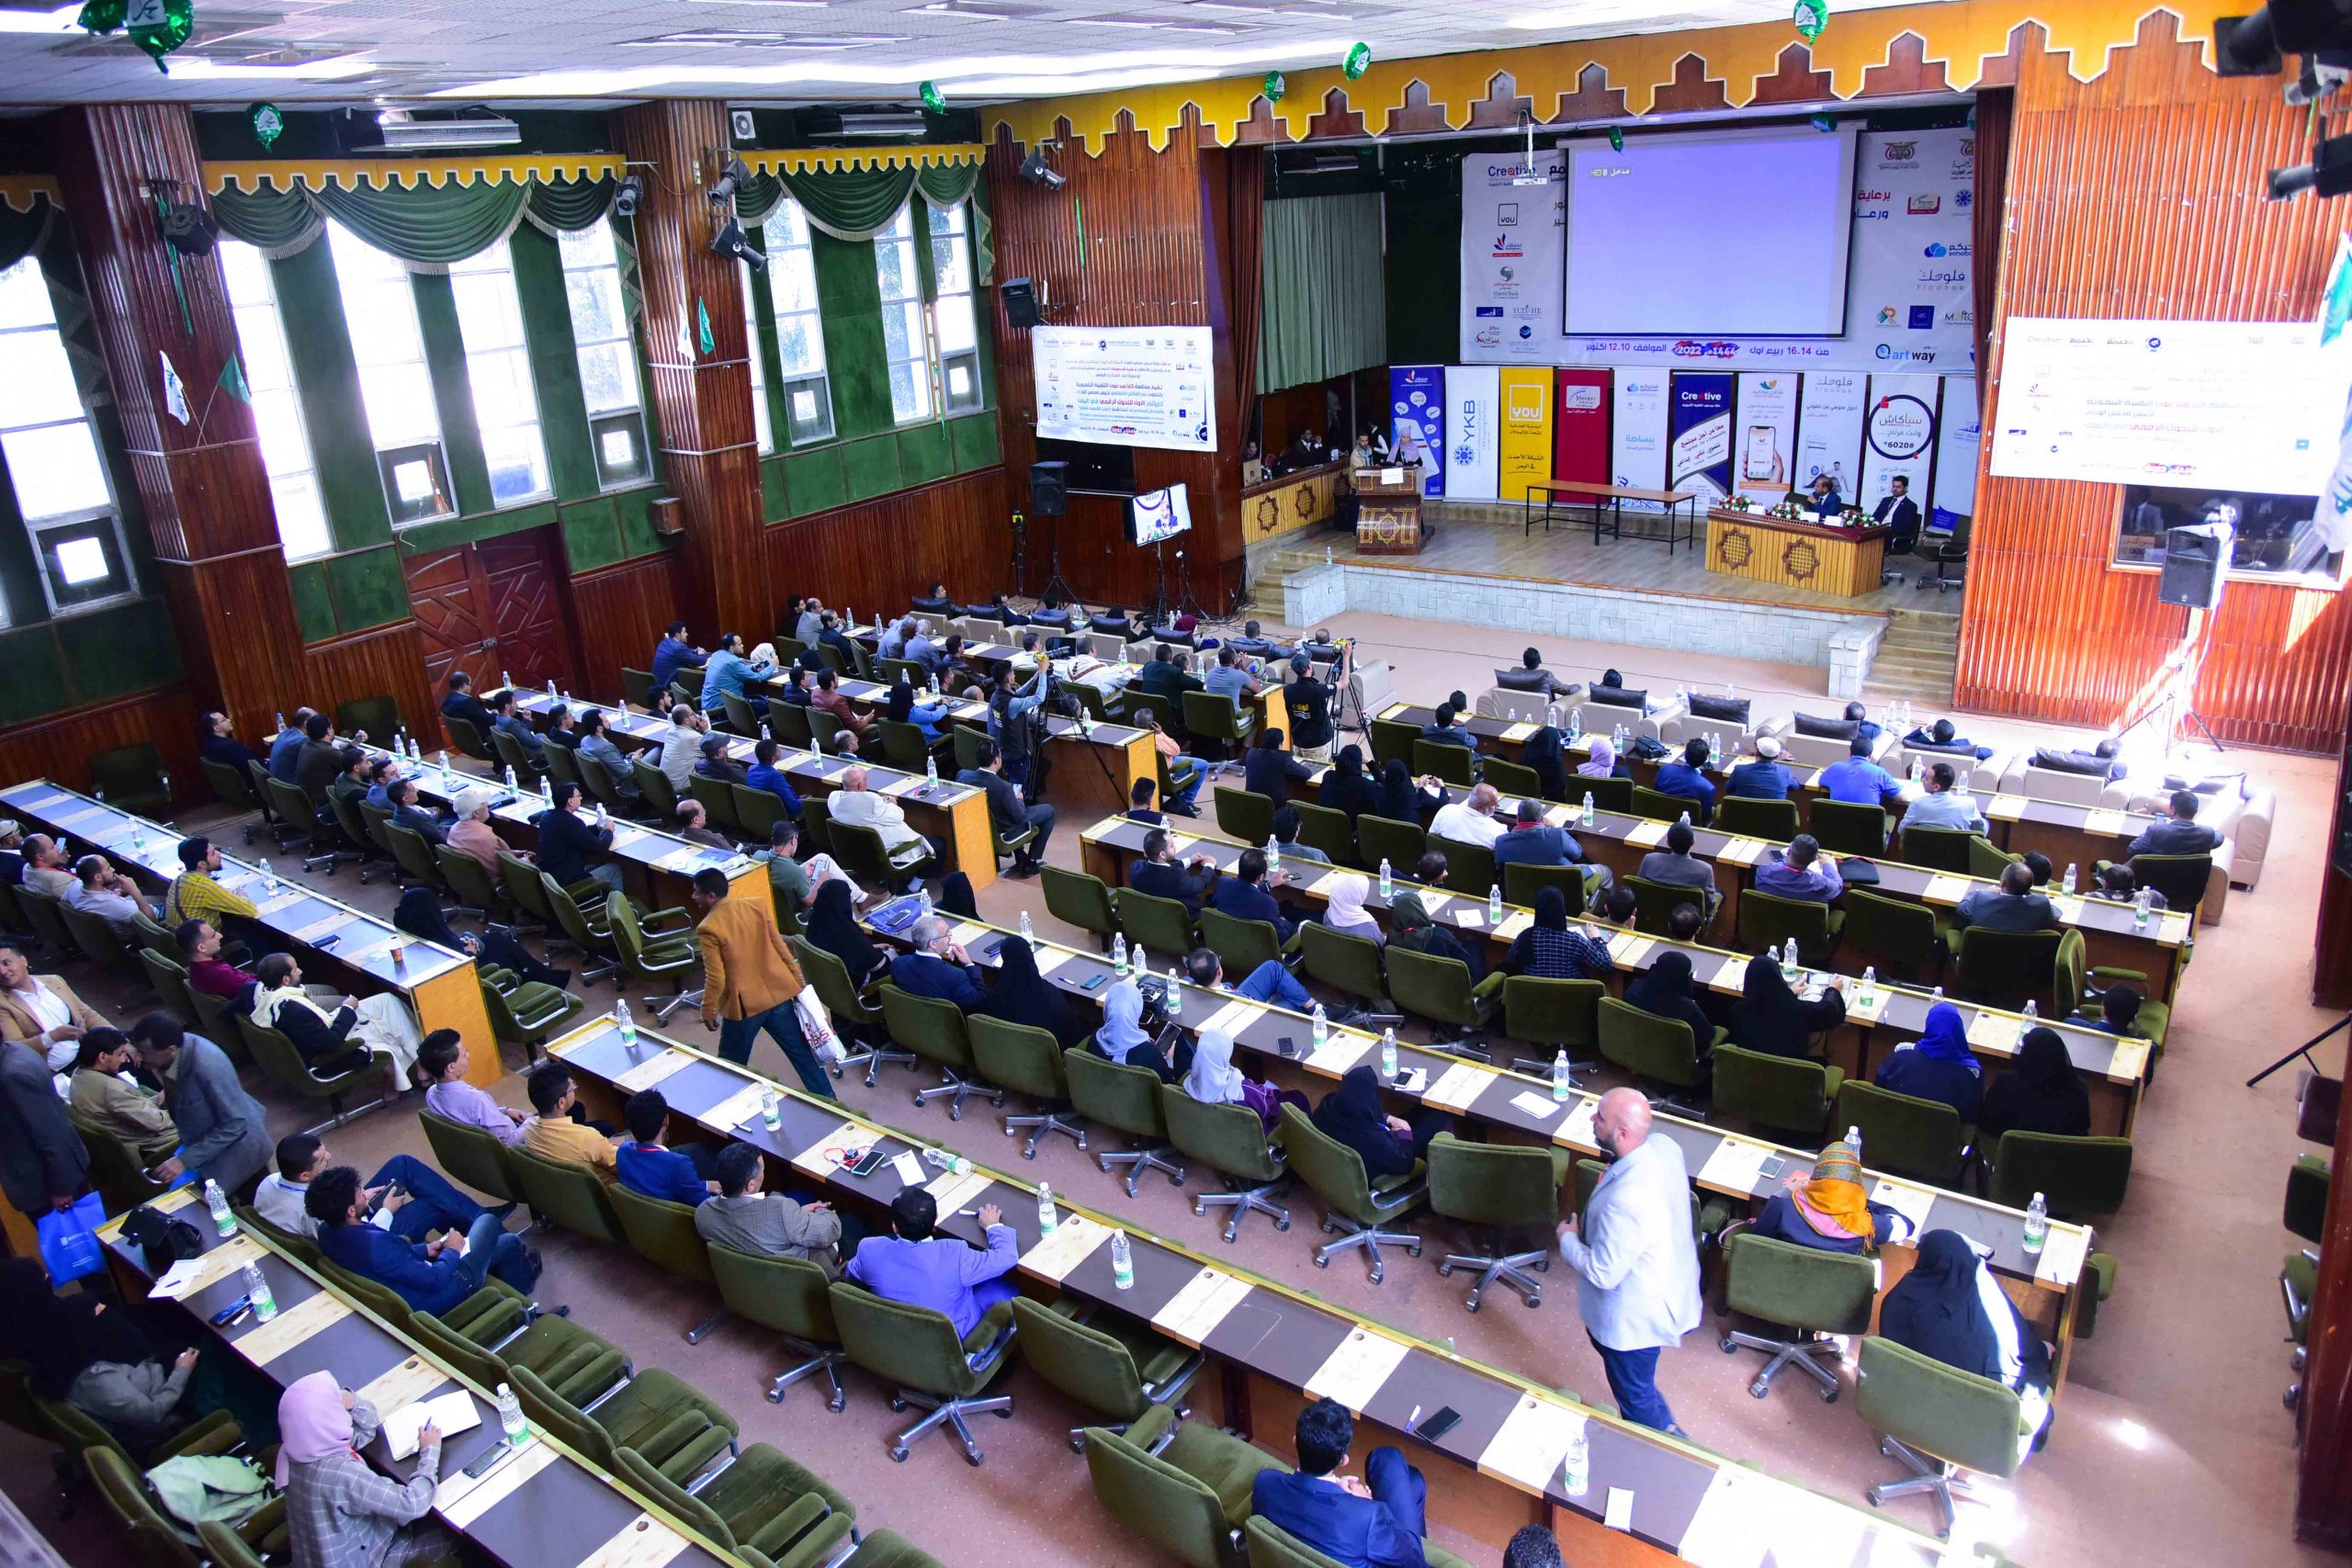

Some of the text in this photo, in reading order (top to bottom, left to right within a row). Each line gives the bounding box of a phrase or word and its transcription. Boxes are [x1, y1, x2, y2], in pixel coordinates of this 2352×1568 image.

[1857, 189, 1891, 201] برعاية
[1856, 209, 1889, 220] ورعا
[1609, 343, 1631, 351] 12.10
[1766, 346, 1783, 356] ربيع
[1815, 346, 1829, 356] من
[1892, 349, 1936, 364] art way
[1511, 407, 1540, 418] YOU
[1464, 400, 1475, 442] YKB
